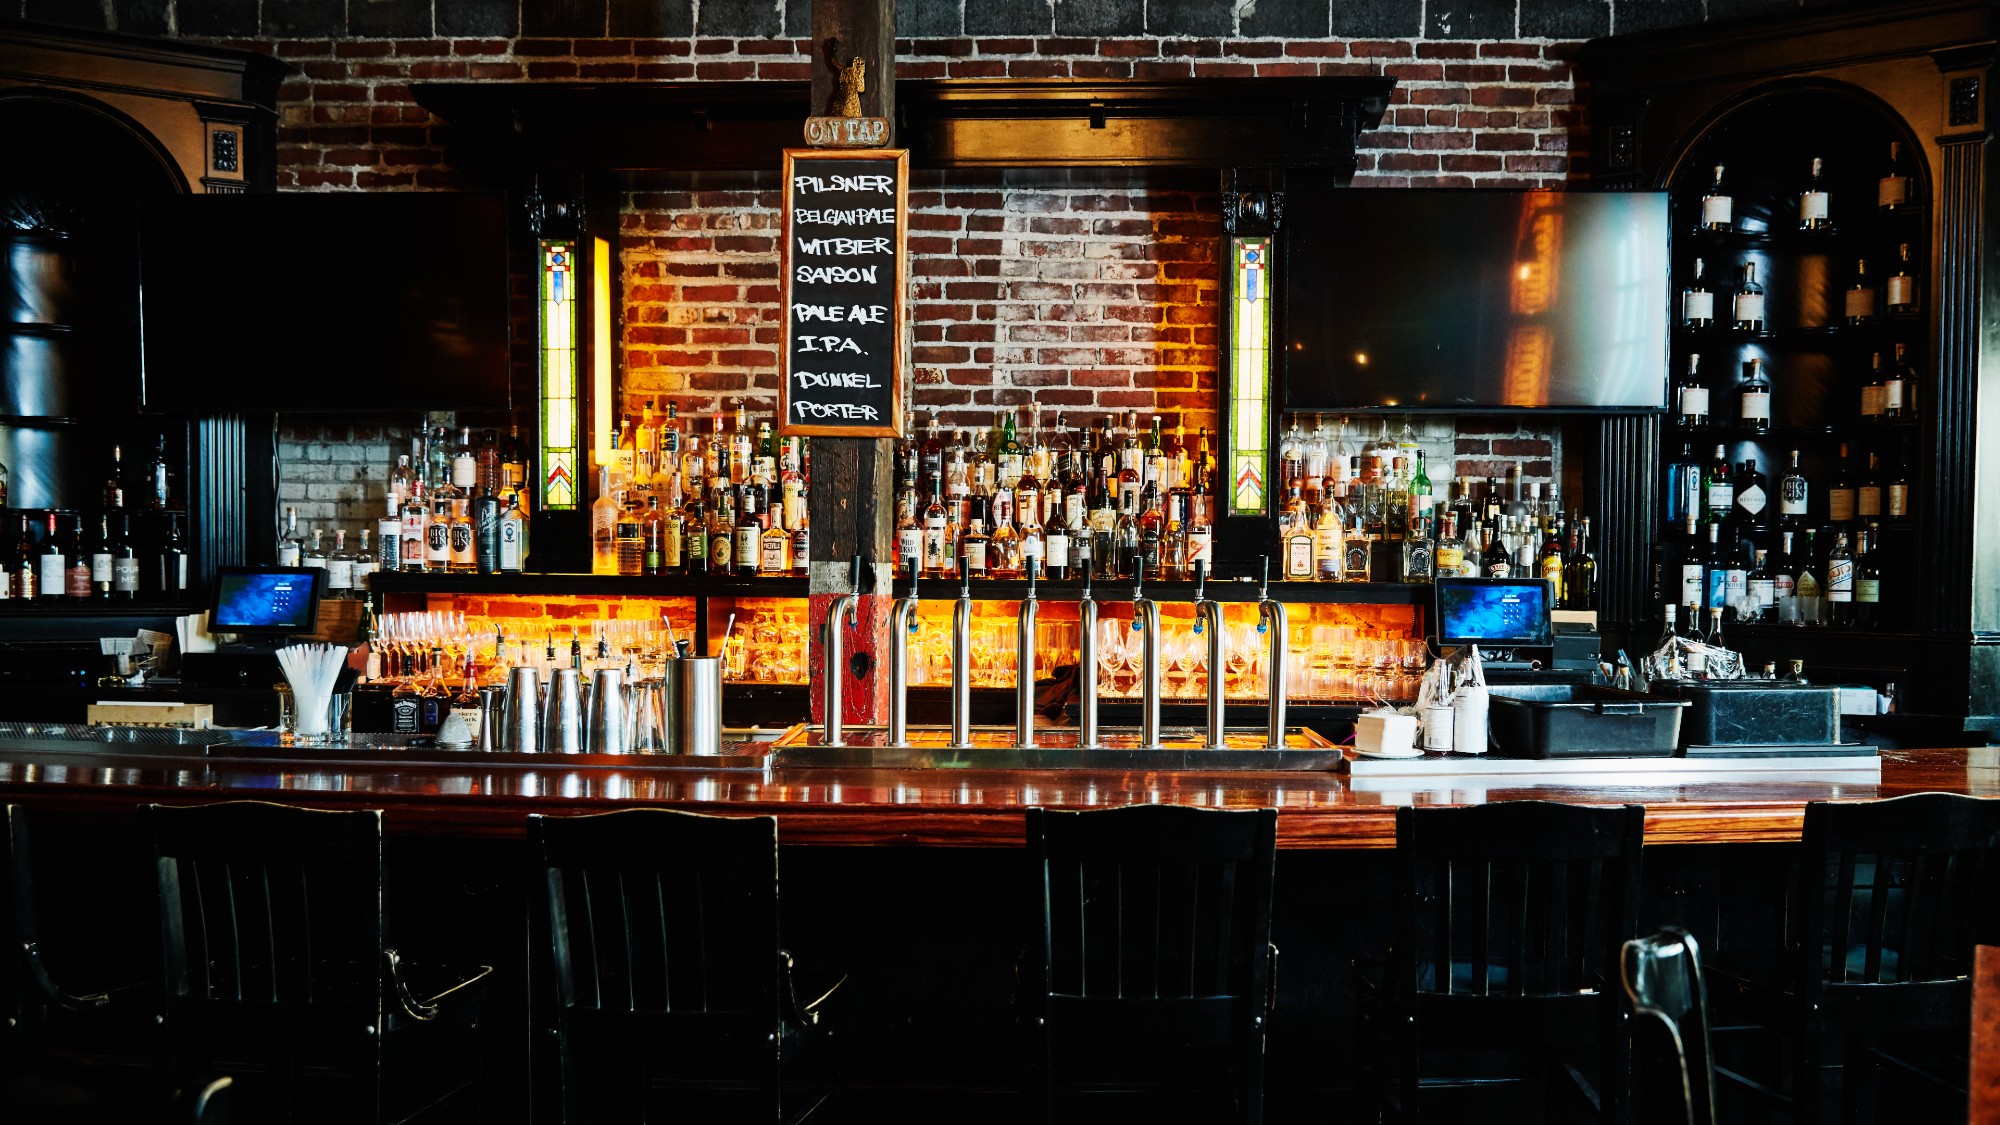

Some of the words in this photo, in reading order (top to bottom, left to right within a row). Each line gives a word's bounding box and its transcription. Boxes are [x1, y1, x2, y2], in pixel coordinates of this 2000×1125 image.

[808, 121, 839, 144] ON
[845, 120, 885, 143] TAP
[794, 175, 894, 196] PILSNER
[797, 236, 894, 256] WITBIER
[796, 265, 877, 285] SAISON
[791, 301, 844, 325] PALE
[847, 304, 888, 325] ALE
[797, 335, 869, 356] I.P.A.
[793, 371, 881, 390] DUNKEL
[792, 400, 879, 421] PORTER
[1784, 490, 1804, 498] GIN
[1786, 481, 1803, 490] BIG
[429, 537, 447, 546] GIN
[430, 528, 447, 537] BIG
[453, 530, 468, 539] BIG
